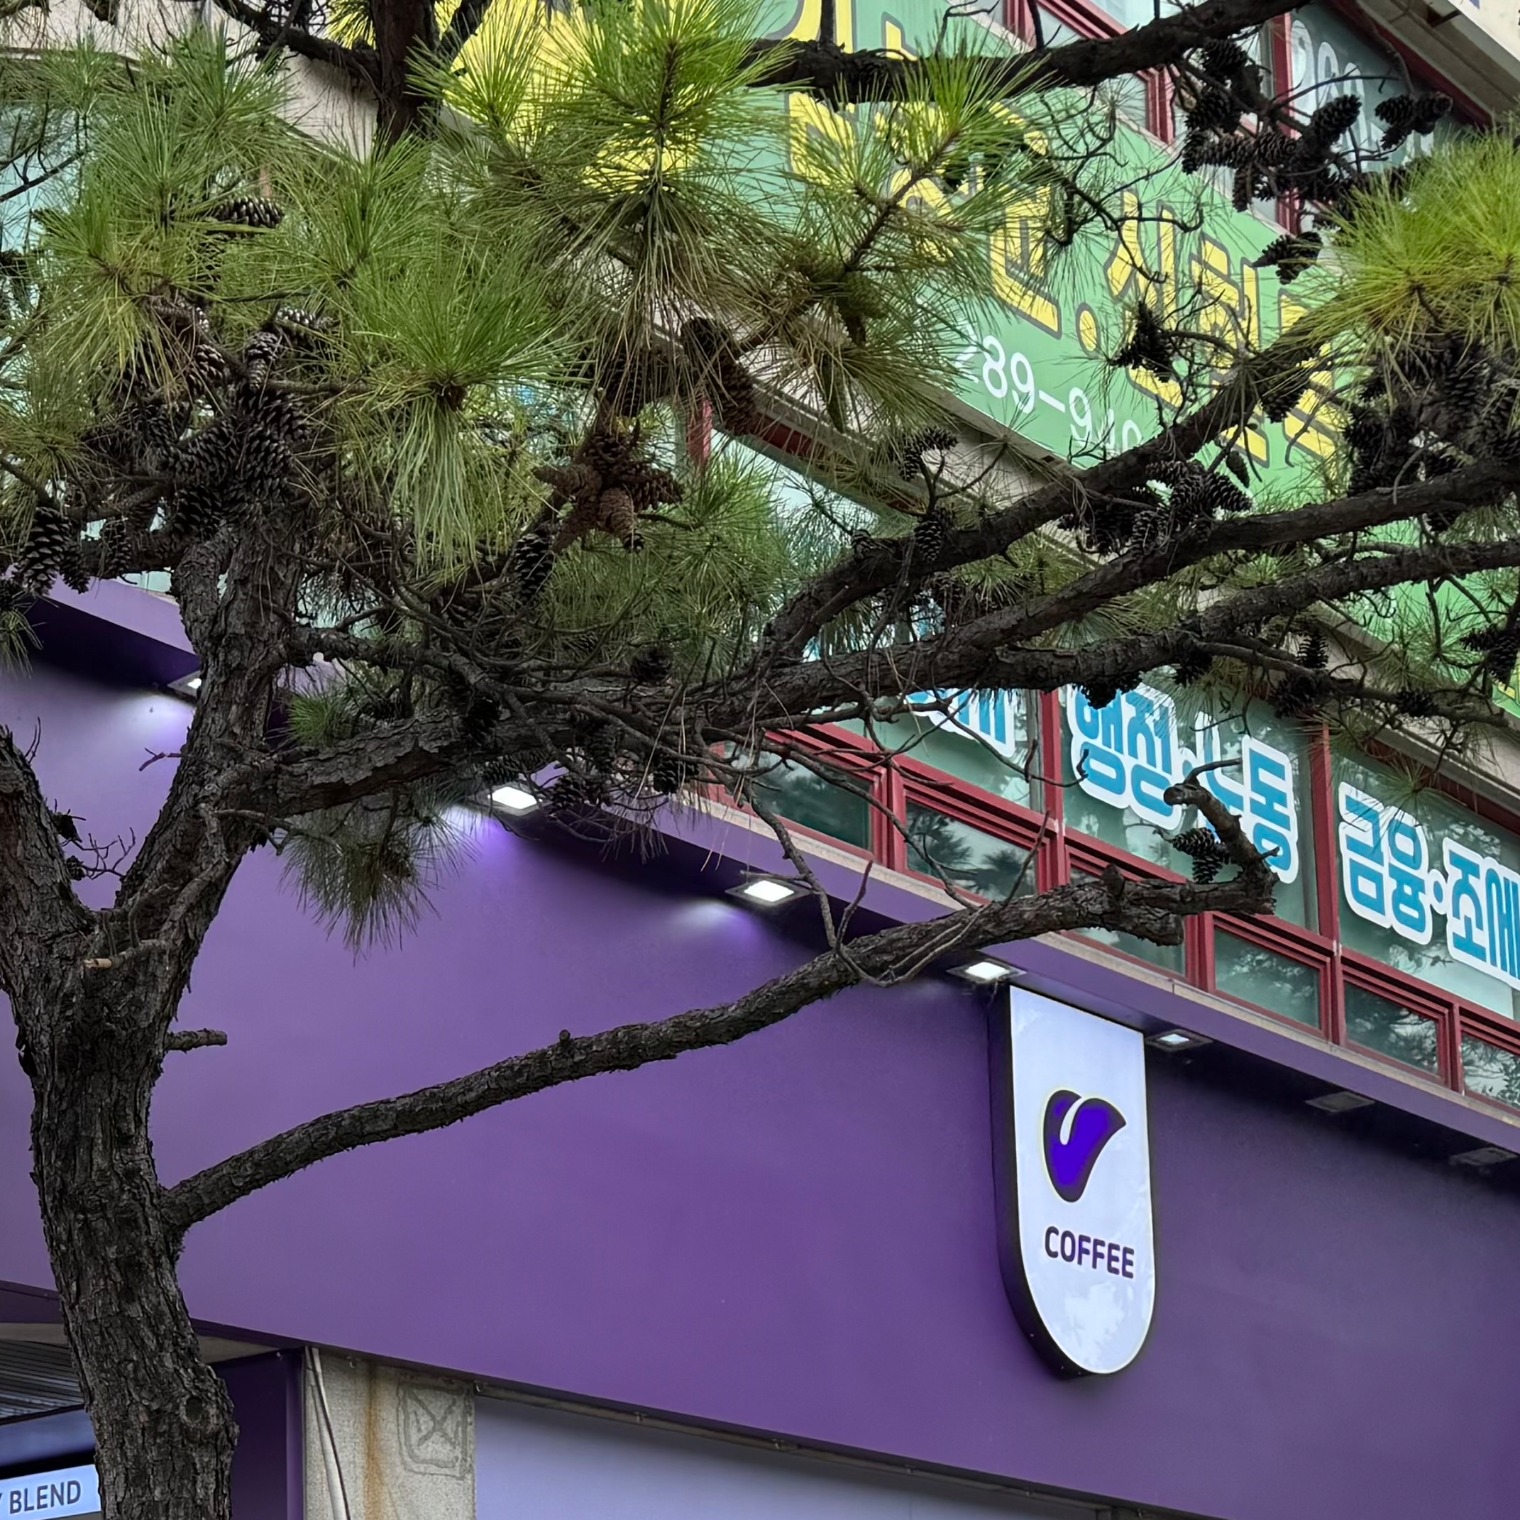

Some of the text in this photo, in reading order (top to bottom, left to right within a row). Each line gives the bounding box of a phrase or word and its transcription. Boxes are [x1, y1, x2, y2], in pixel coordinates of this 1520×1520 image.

[1345, 794, 1520, 980] 금융·조세
[1044, 1226, 1135, 1280] COFFEE
[9, 1479, 82, 1517] BLEND
